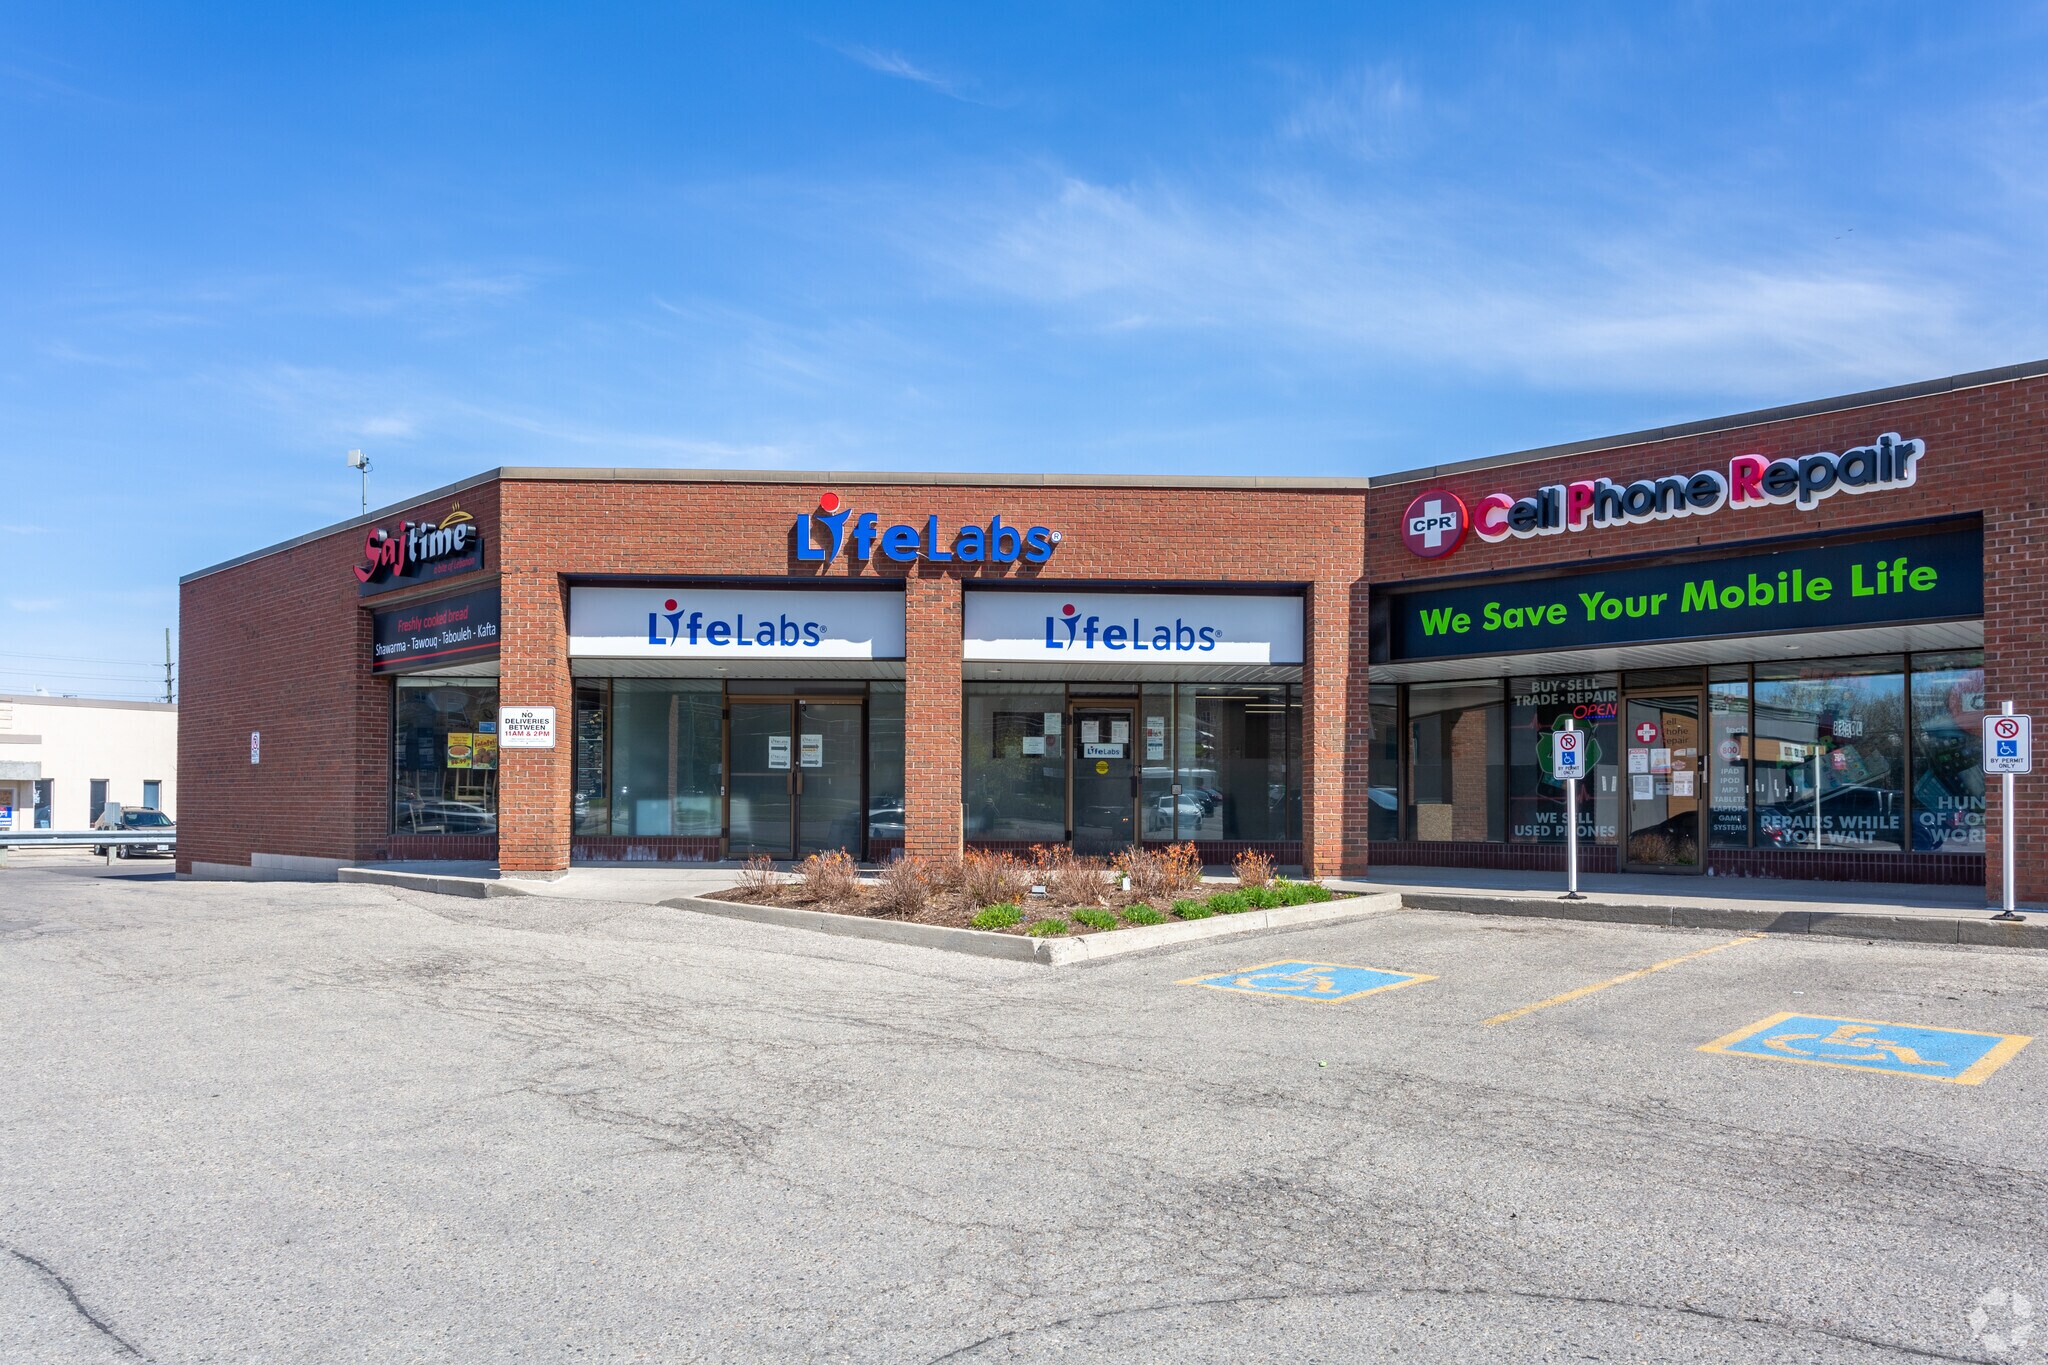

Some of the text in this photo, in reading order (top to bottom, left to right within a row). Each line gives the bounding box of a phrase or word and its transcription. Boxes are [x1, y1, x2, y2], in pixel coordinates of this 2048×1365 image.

[1474, 435, 1916, 537] Cell Phone Repair
[1413, 516, 1452, 533] CPR
[1420, 557, 1938, 636] We Save Your Mobile Life
[397, 605, 469, 633] Freshly cooked bread
[375, 641, 407, 656] Shawarma
[411, 636, 438, 650] Tawouq
[442, 626, 472, 645] Tabouleh
[477, 621, 496, 638] Kafta
[1531, 678, 1600, 694] BUY SELL
[1514, 690, 1618, 707] TRADE REPAIR
[1573, 703, 1618, 719] OPEN
[1087, 745, 1120, 755] LifeLabs
[1535, 812, 1593, 824] WE SLL
[1718, 814, 1742, 822] GAME
[1838, 815, 1900, 829] WHILE
[1919, 812, 1947, 826] OF
[1514, 824, 1551, 837] USED
[1827, 830, 1876, 844] WAIT
